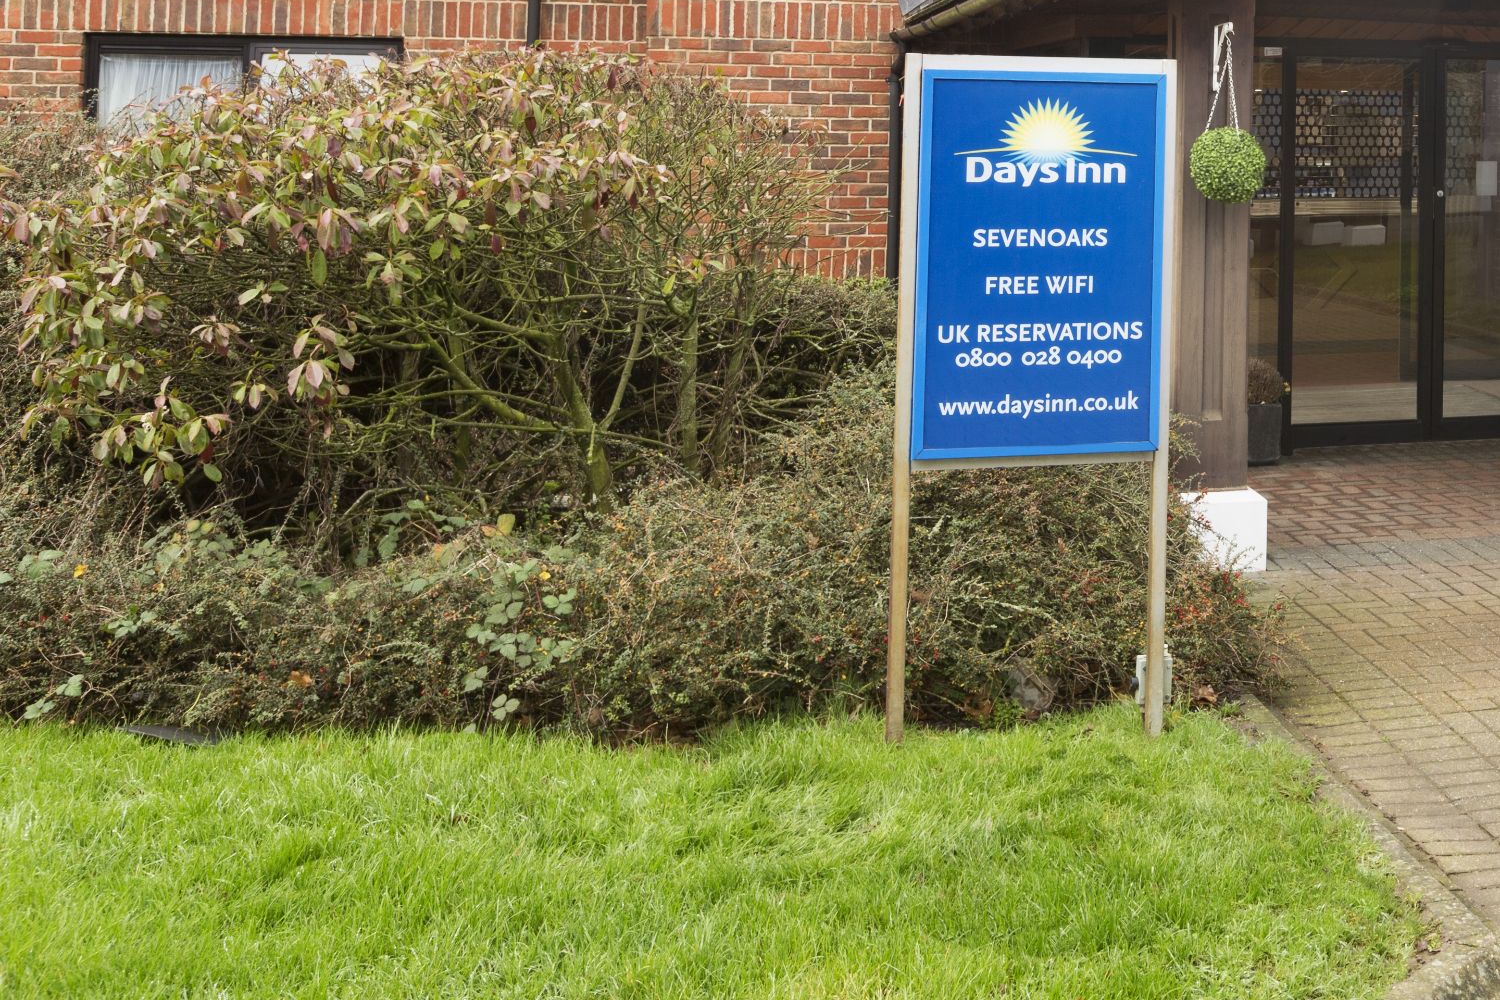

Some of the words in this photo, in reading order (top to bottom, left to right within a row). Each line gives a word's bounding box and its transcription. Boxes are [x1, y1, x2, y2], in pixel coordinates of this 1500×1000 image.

[965, 157, 1060, 187] Days
[1066, 157, 1127, 184] Inn
[973, 228, 1108, 248] SEVENOAKS
[985, 276, 1039, 295] FREE
[1046, 276, 1094, 294] WIFI
[938, 325, 968, 344] UK
[977, 321, 1143, 343] RESERVATIONS
[955, 347, 1012, 367] 0800
[1022, 346, 1060, 366] 028
[1067, 349, 1122, 369] 0400
[939, 390, 1139, 419] www.daysinn.co.uk
